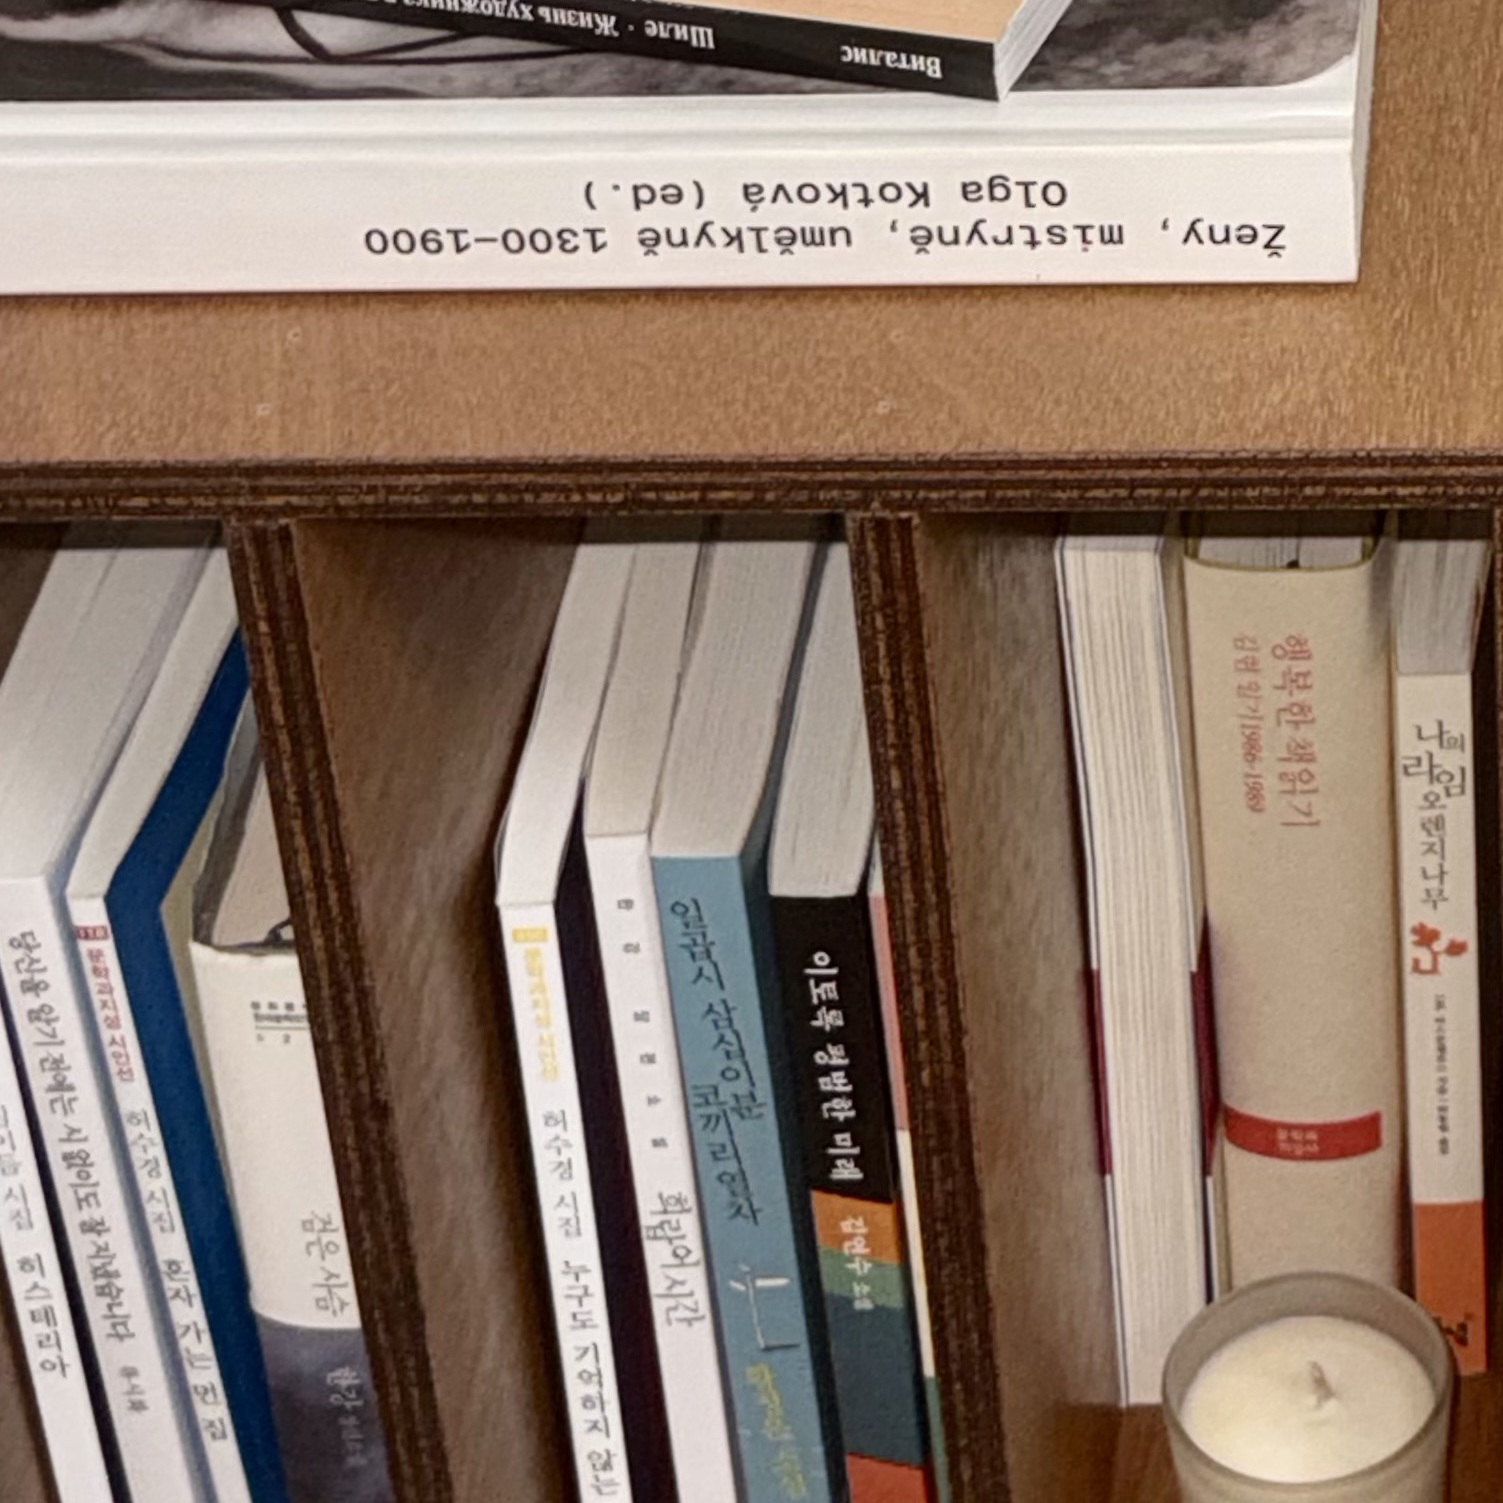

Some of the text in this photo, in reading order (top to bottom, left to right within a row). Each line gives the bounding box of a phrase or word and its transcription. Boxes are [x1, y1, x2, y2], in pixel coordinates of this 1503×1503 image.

[538, 2, 619, 38] Жизнь
[644, 19, 715, 50] Шиле
[840, 43, 942, 79] Виталис
[583, 179, 706, 211] (ed.)
[960, 174, 1068, 209] Olga
[637, 221, 854, 256] umělkyně
[889, 218, 1125, 255] mistryně,
[1159, 218, 1287, 259] Ženy,
[1232, 633, 1258, 672] 김현
[1272, 631, 1321, 829] 행복한 책읽기
[1412, 719, 1466, 753] 나의
[1402, 749, 1467, 797] 라임
[9, 930, 50, 997] 당신을
[27, 1003, 66, 1046] 알기
[38, 1051, 79, 1117] 전에는
[803, 950, 865, 1181] 이토록 평범한 미래
[58, 1123, 89, 1144] 시
[543, 1109, 575, 1182] 허수경
[61, 1148, 102, 1211] 없이도
[554, 1191, 582, 1239] 시집
[301, 1210, 351, 1318] 검은 사슴
[643, 1191, 707, 1327] 희랍어 시간
[839, 1215, 874, 1277] 김연수
[561, 1260, 600, 1332] 누구도
[573, 1341, 611, 1441] 기억하지
